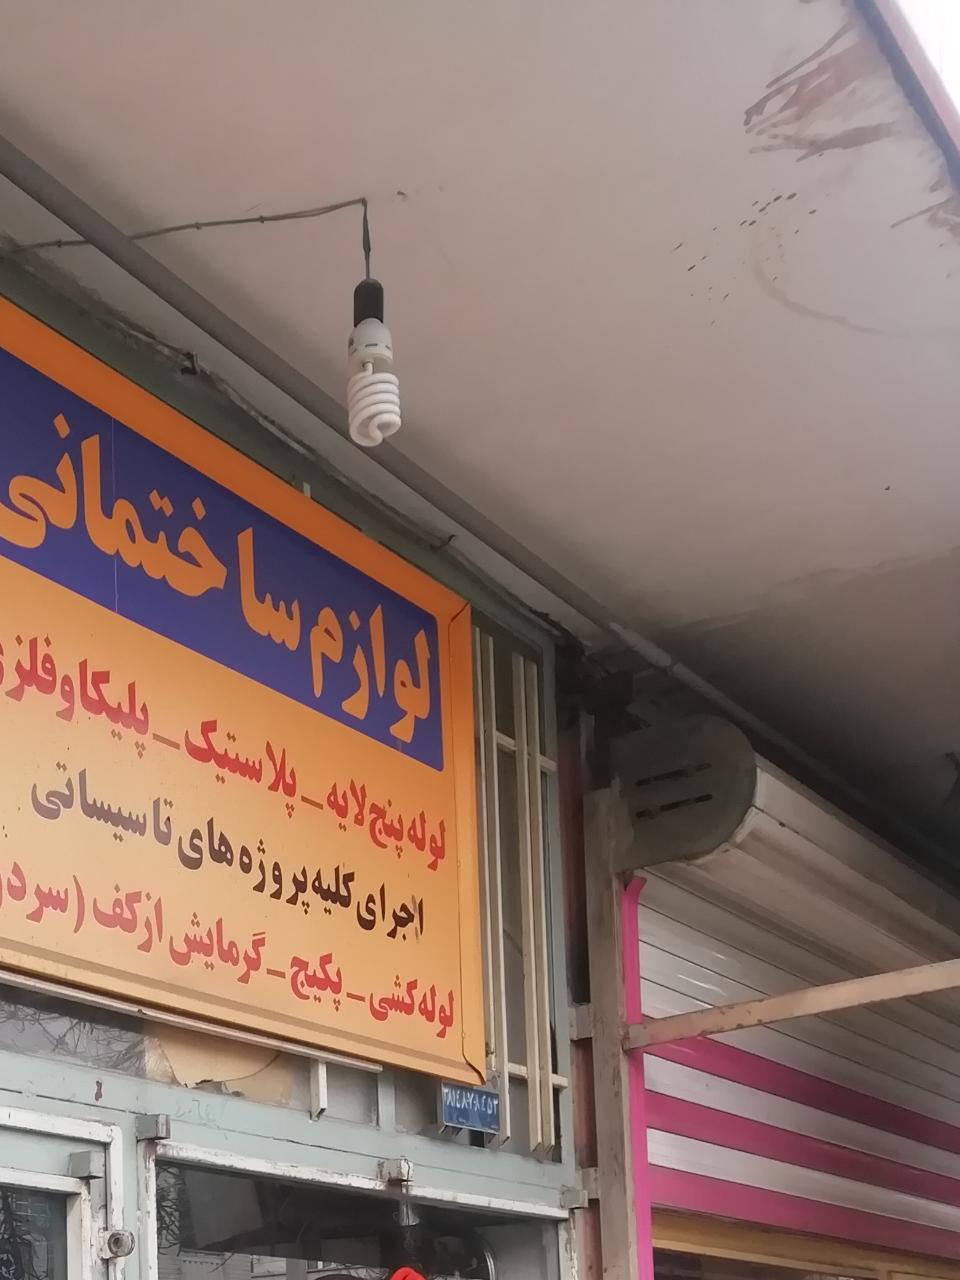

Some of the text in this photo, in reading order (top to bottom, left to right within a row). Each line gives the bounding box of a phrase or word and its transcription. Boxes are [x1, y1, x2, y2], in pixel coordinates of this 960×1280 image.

[310, 604, 431, 743] لوازم
[184, 719, 297, 818] پلاستیک
[326, 778, 368, 832] لایه
[369, 799, 404, 859] پنج
[31, 760, 425, 942] اجرای کلیه پروژه های تاسیساتی
[407, 811, 446, 871] لوله
[92, 884, 142, 935] کف
[137, 892, 164, 952] از
[168, 911, 267, 984] گرمایش
[290, 952, 343, 1012] پکیج
[369, 974, 417, 1022] کشی
[418, 988, 455, 1038] لوله
